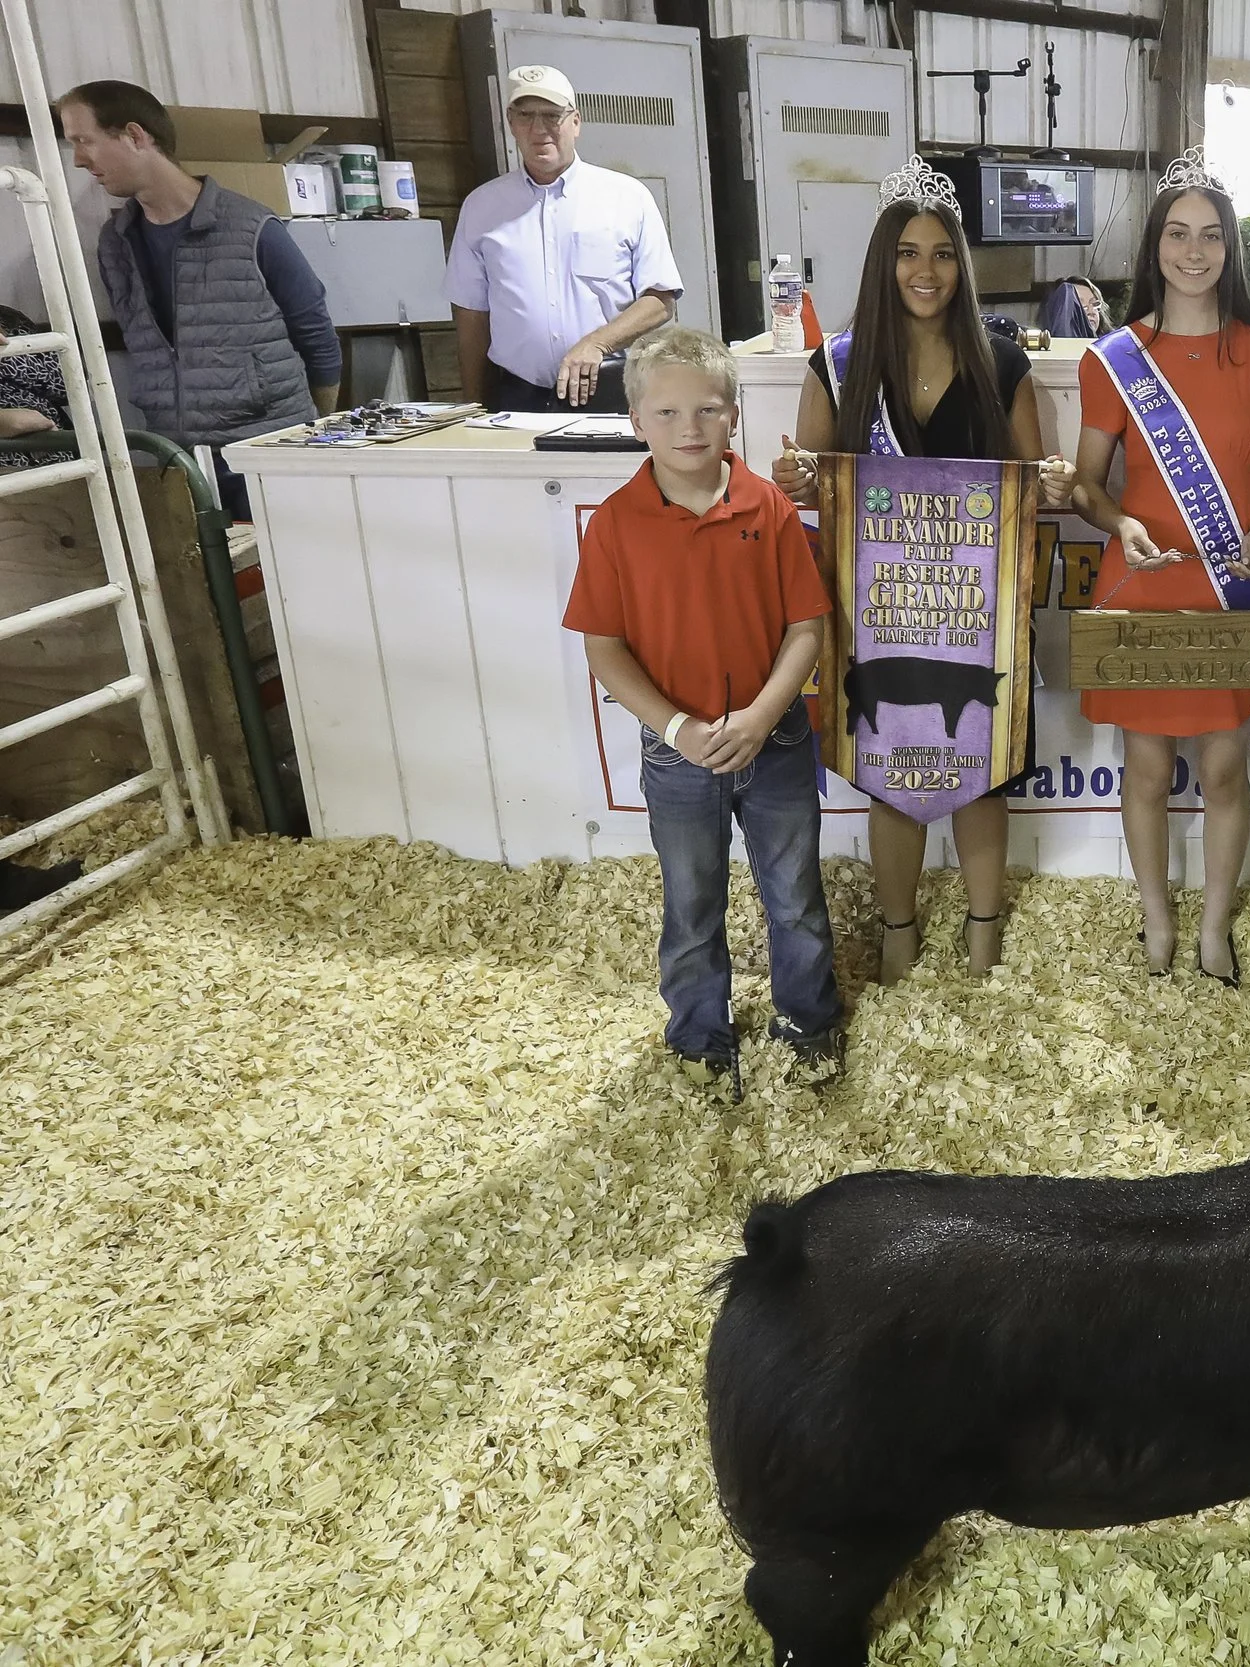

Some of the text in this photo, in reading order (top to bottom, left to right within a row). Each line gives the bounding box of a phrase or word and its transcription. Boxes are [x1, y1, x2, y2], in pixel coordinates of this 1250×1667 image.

[1139, 395, 1168, 415] 2025
[871, 420, 892, 457] Wes
[1175, 425, 1241, 561] West Alexande
[898, 493, 960, 519] WEST
[1151, 426, 1232, 586] Fair Princess
[862, 517, 995, 546] ALEXANDER
[903, 544, 952, 561] FAIR
[873, 562, 981, 585] RESERVE
[868, 581, 986, 611] GRAND
[862, 607, 990, 630] CHAMPION
[874, 629, 978, 646] MARKET HOG
[861, 752, 987, 768] THE ROHALEY FAMILY
[891, 746, 956, 755] SPONSORED BY
[884, 769, 961, 790] 2025
